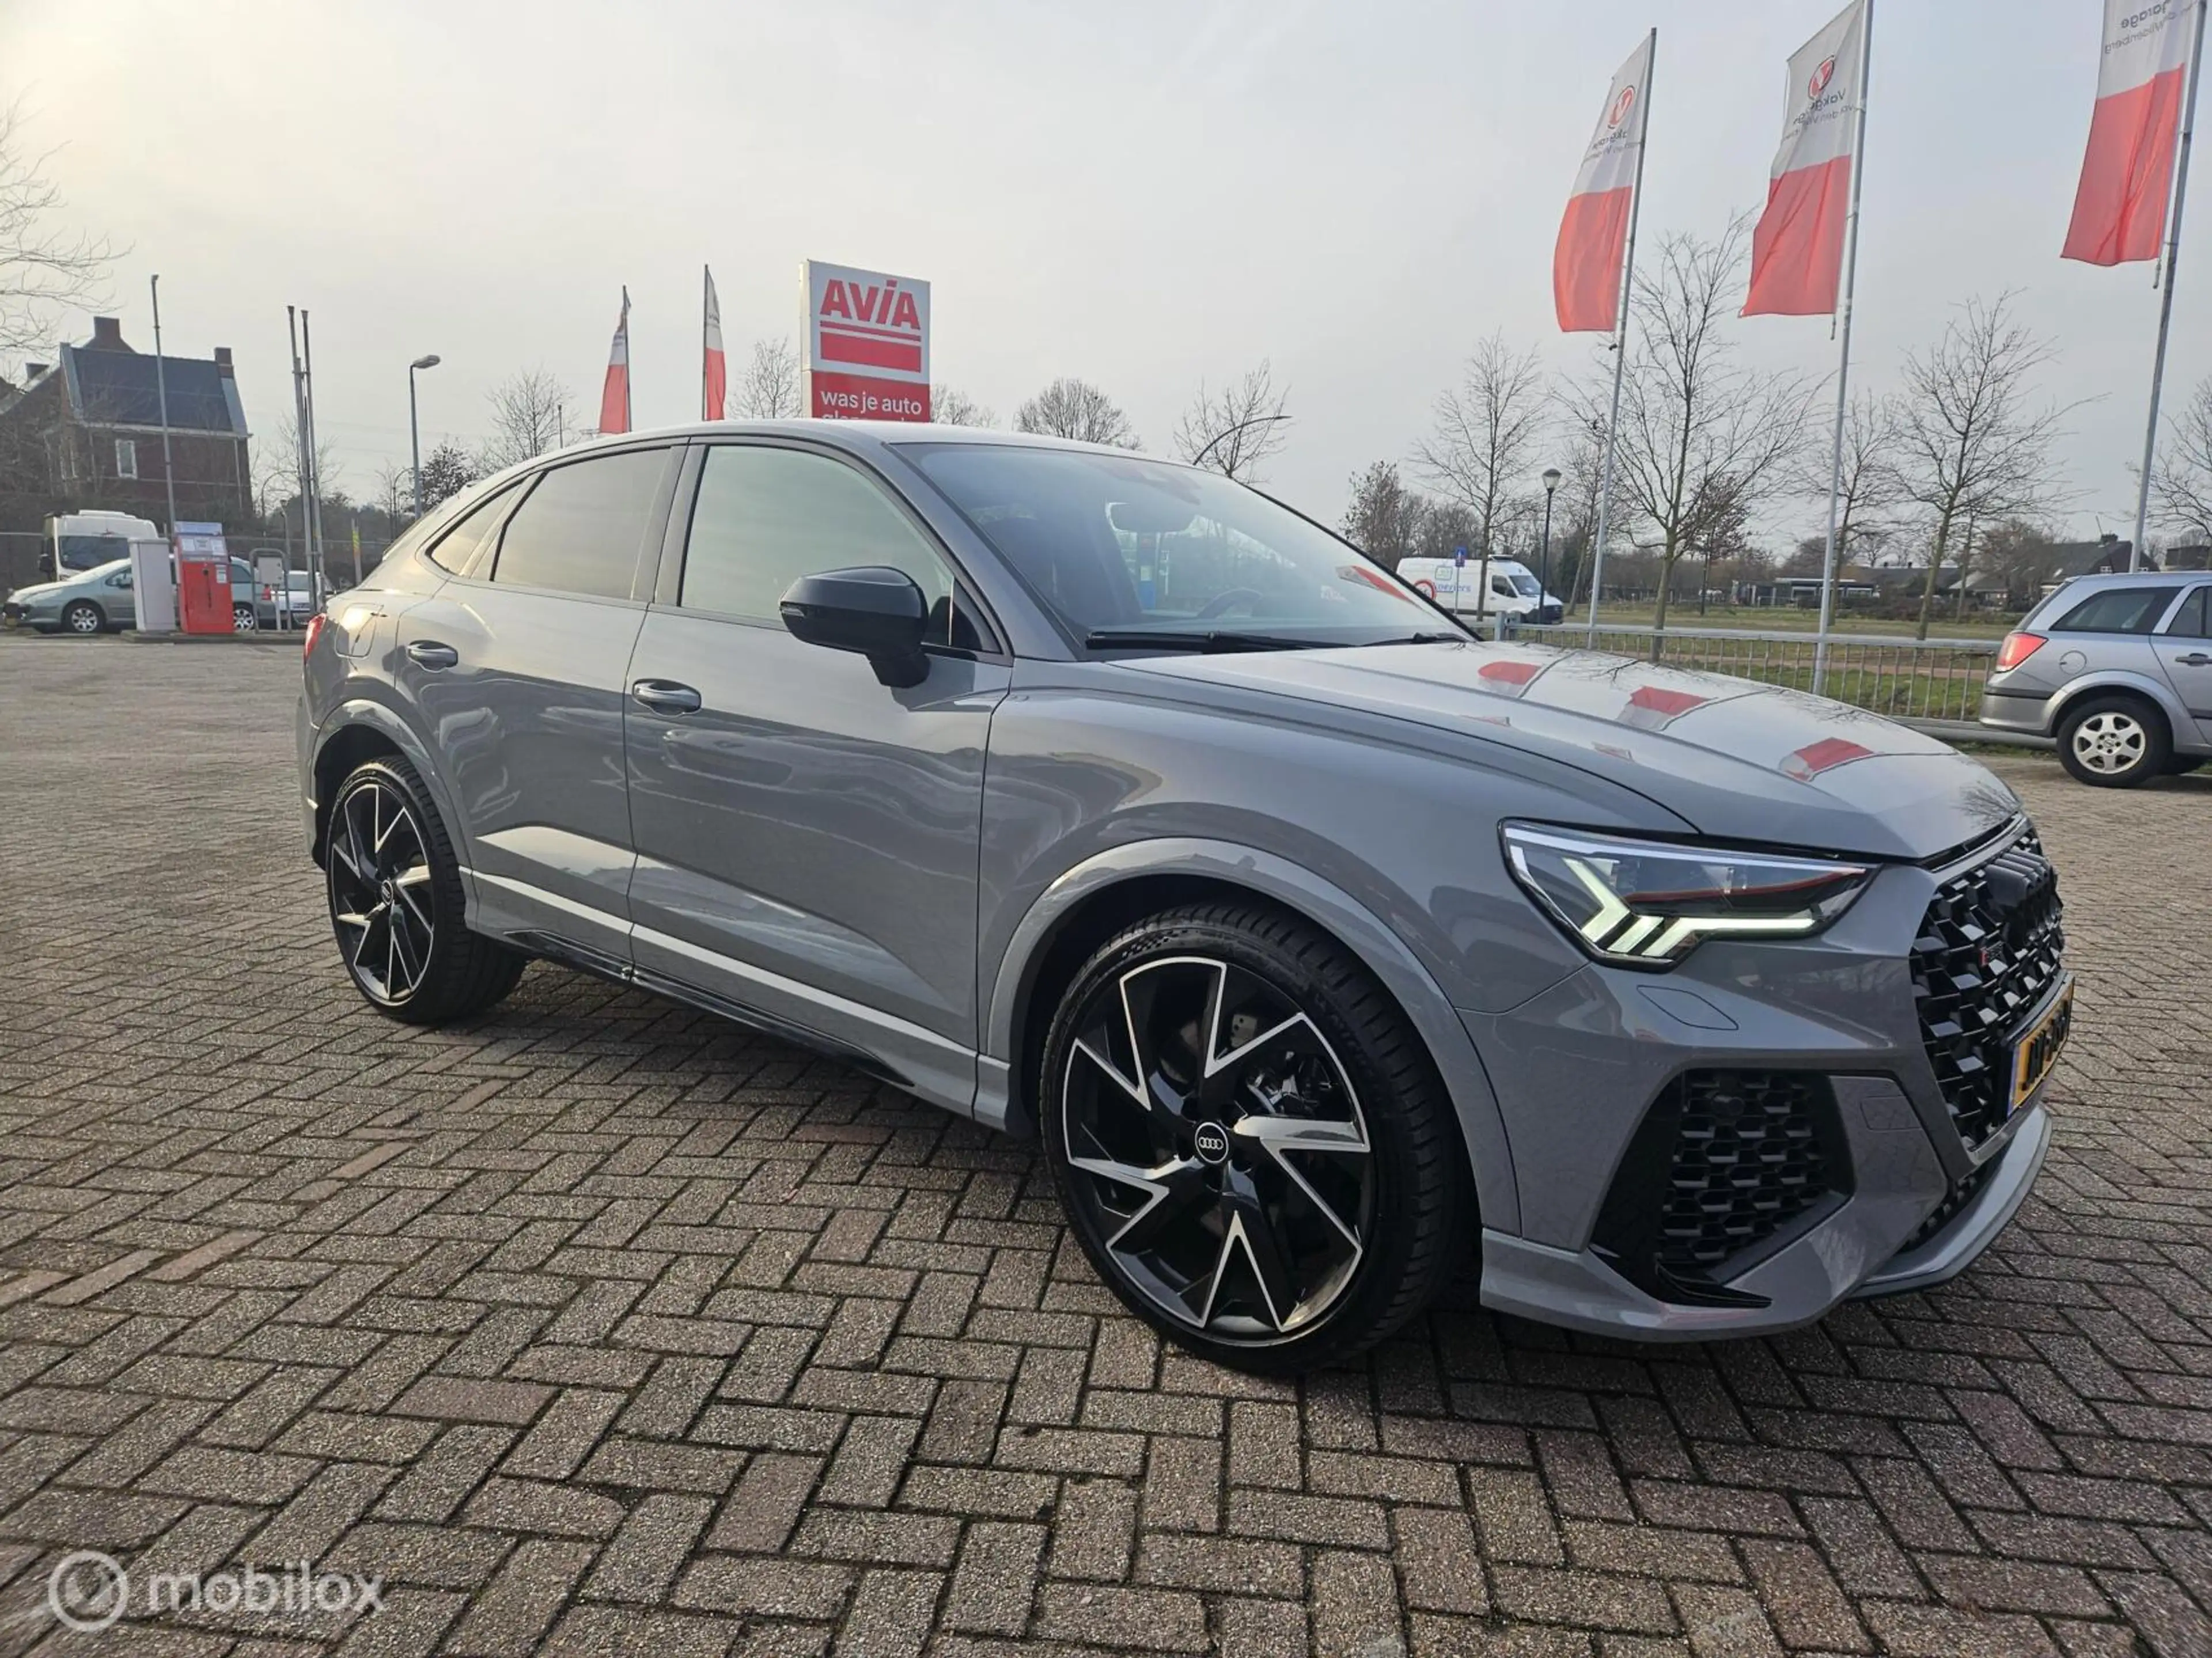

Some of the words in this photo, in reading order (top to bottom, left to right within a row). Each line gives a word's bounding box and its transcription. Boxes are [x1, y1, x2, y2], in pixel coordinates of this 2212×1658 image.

[820, 390, 858, 408] was
[861, 391, 878, 413] je
[882, 398, 922, 415] auto
